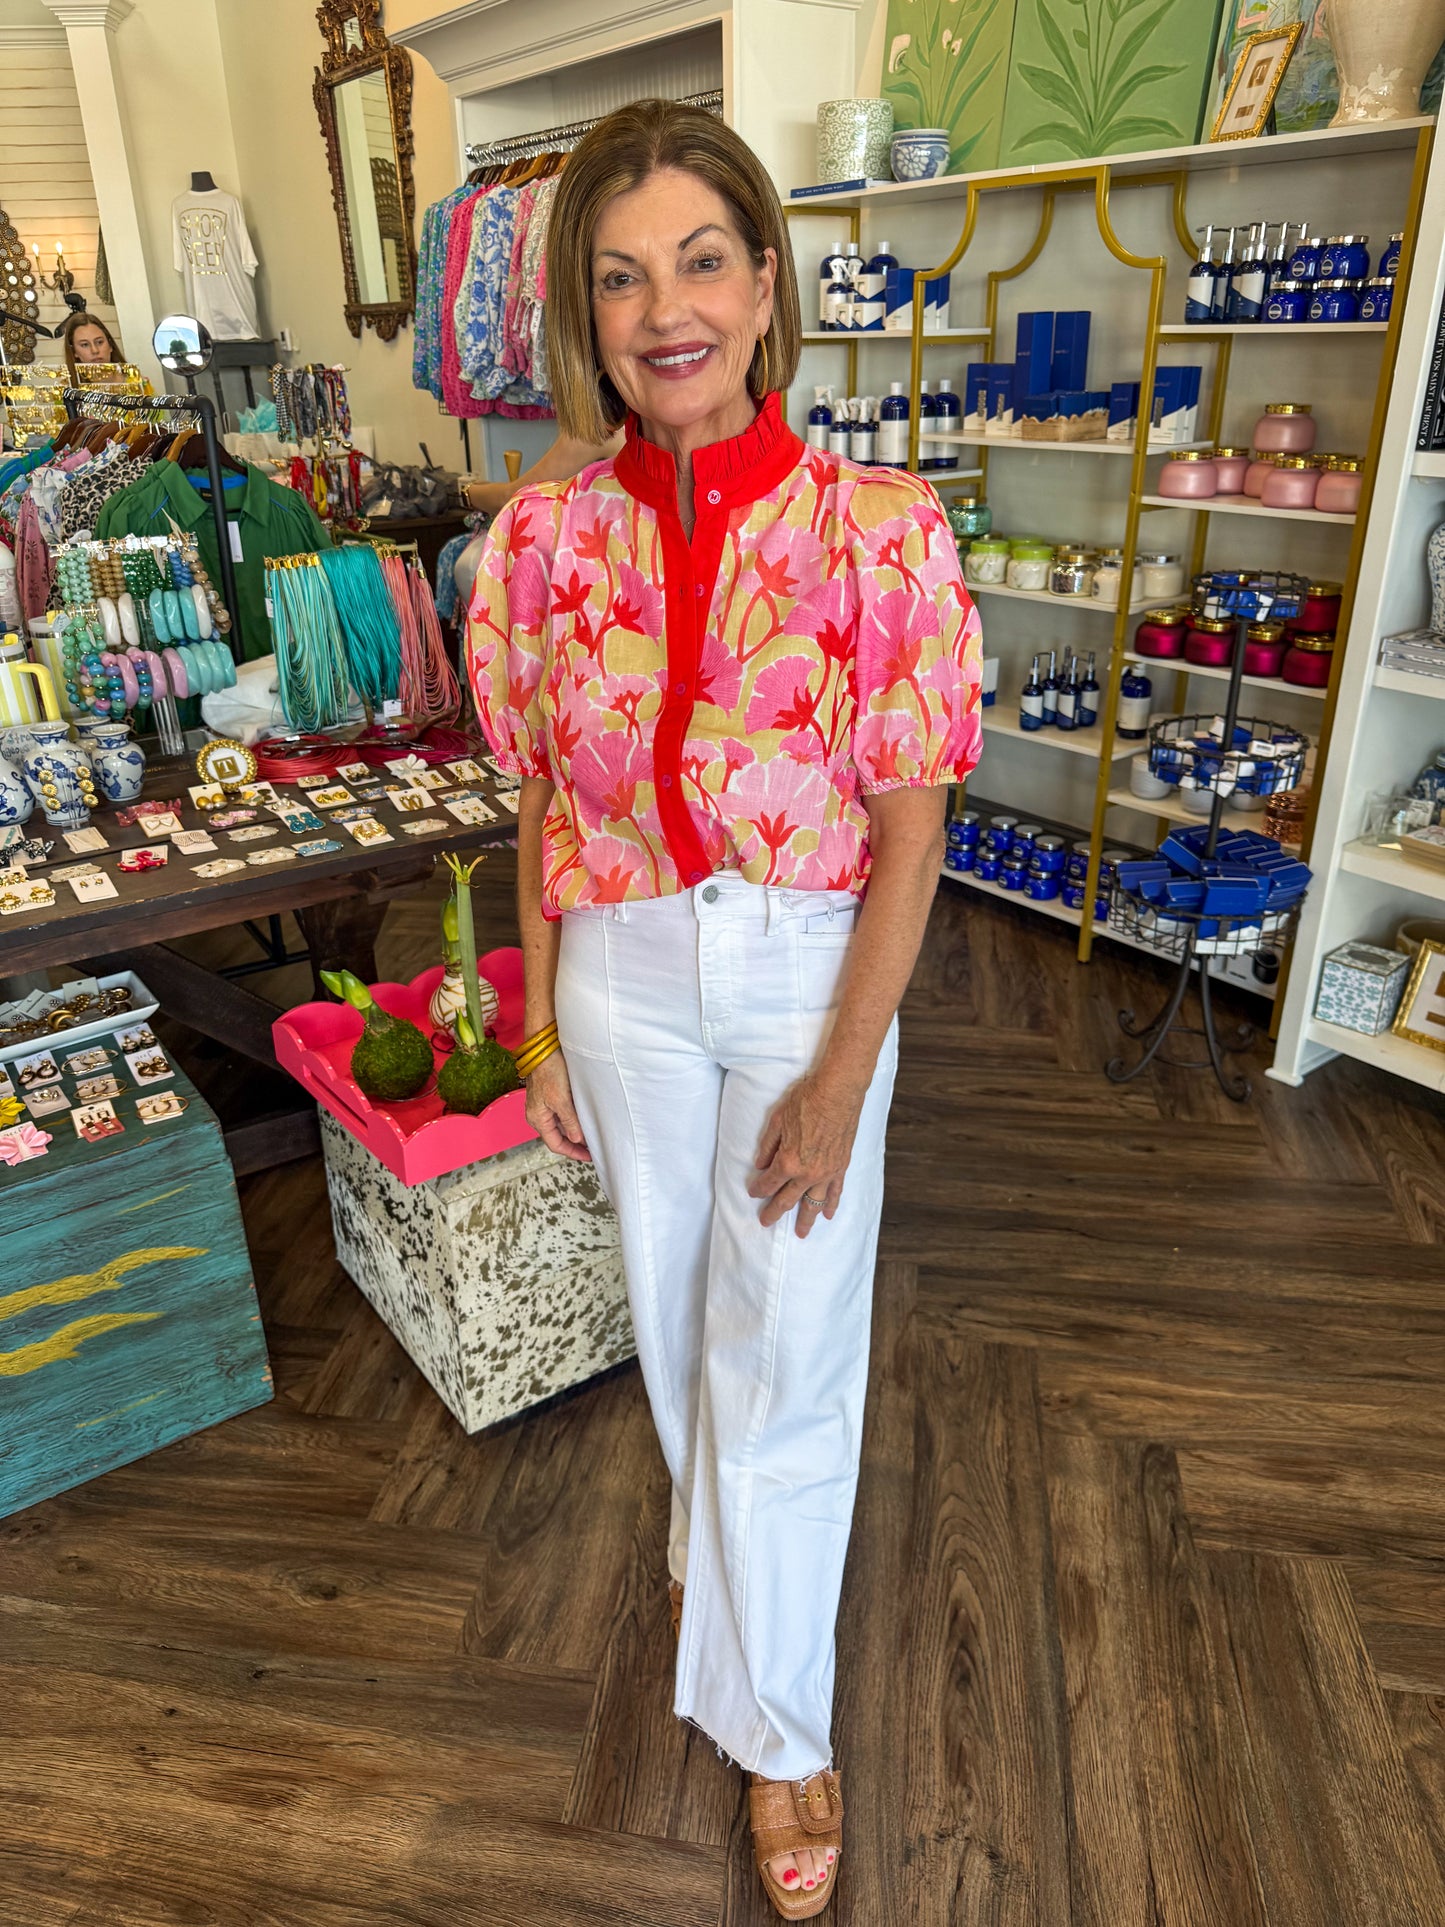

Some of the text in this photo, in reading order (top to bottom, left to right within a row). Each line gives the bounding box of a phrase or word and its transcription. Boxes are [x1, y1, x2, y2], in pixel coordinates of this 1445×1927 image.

[1433, 348, 1443, 371] YVES
[1427, 371, 1439, 397] SAINT
[1420, 398, 1434, 437] LAURENT
[217, 759, 233, 773] T
